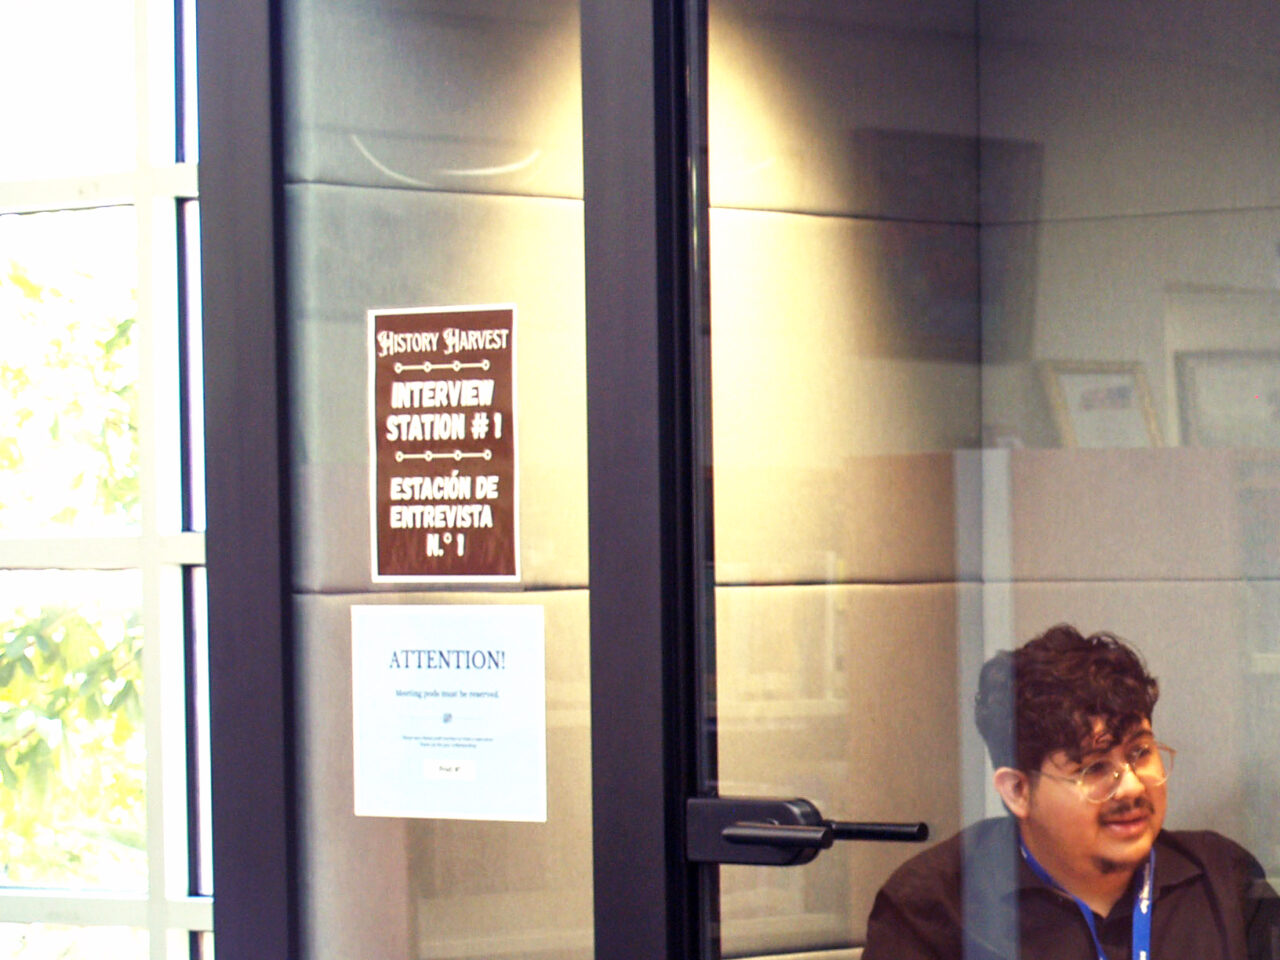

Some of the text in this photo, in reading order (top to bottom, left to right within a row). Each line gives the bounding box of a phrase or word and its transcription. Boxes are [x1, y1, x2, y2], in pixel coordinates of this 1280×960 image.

[391, 380, 495, 408] INTERVIEW
[386, 413, 464, 441] STATION
[494, 412, 502, 439] 1
[390, 470, 499, 500] ESTACIÓN DE
[390, 505, 493, 529] ENTREVISTA
[457, 534, 464, 556] 1
[390, 651, 506, 669] ATTENTION!
